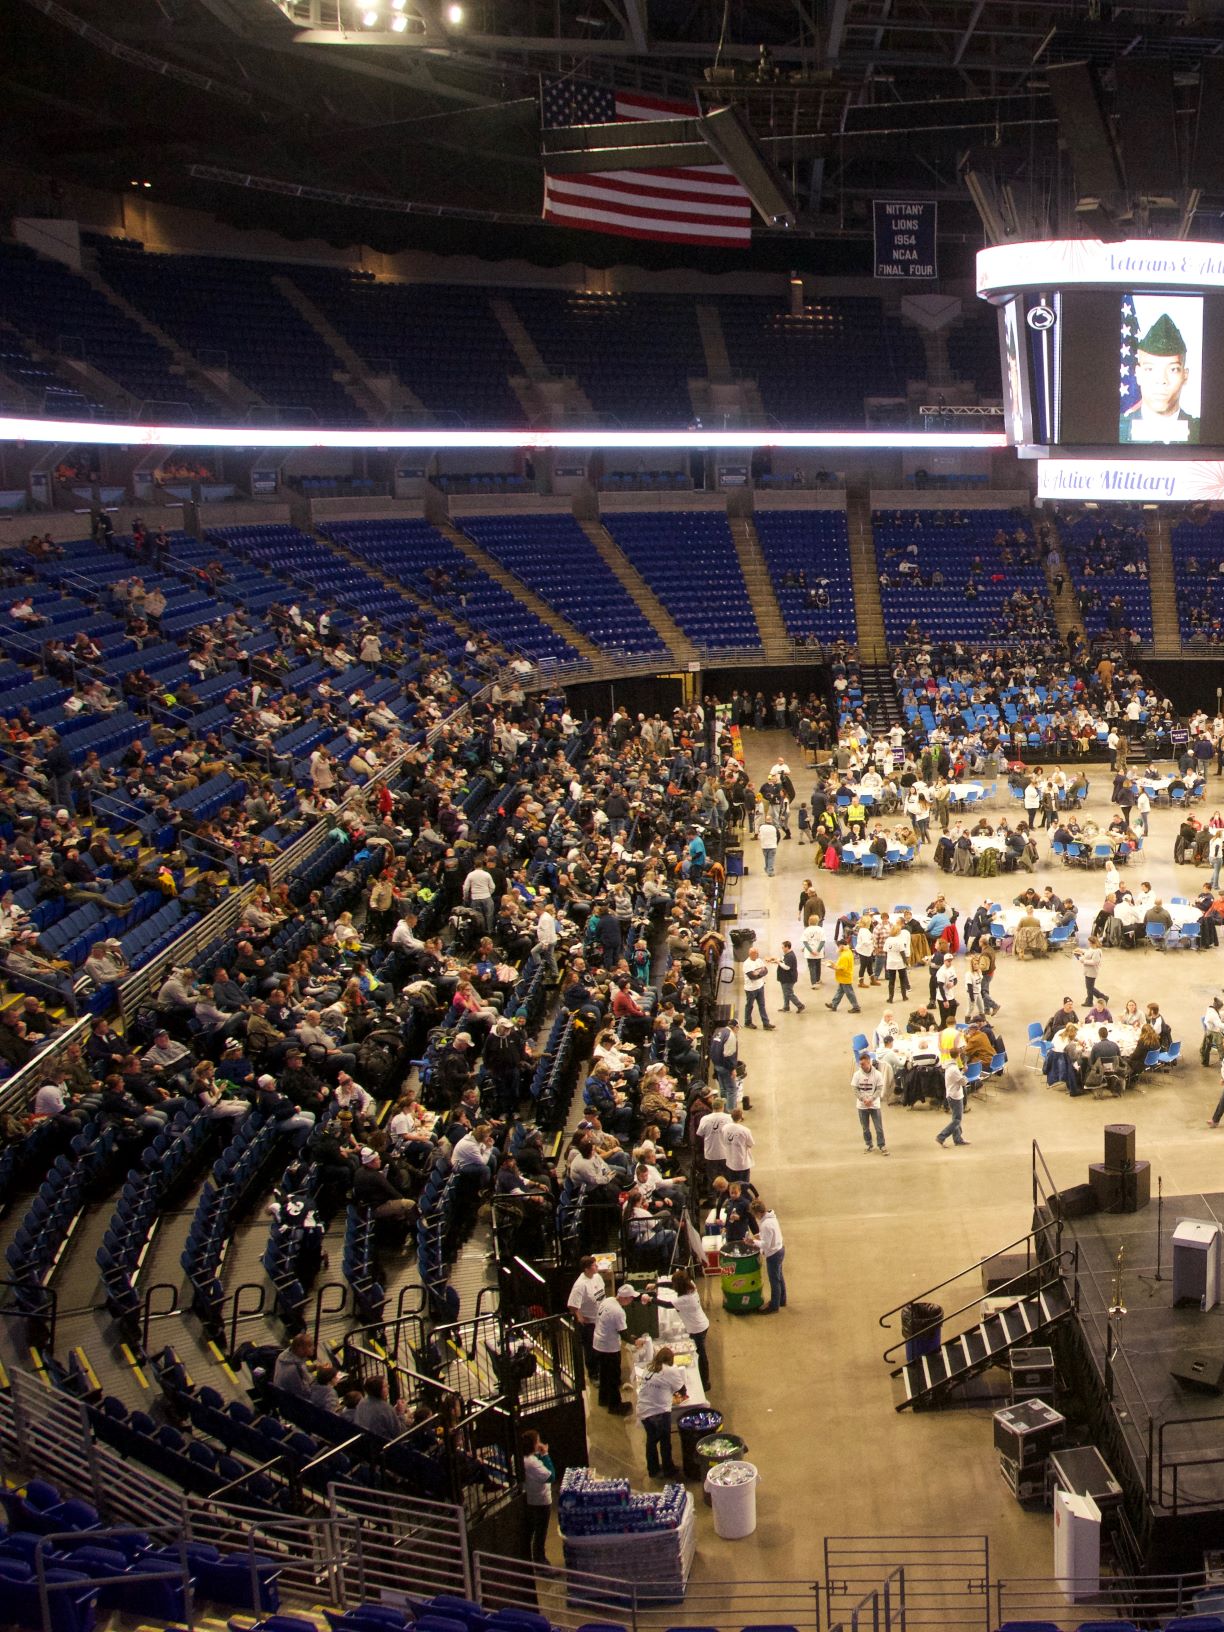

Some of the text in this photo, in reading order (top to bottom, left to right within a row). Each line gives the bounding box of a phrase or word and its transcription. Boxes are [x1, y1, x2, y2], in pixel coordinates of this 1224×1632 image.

[886, 204, 924, 215] NITTANY
[892, 219, 919, 230] LIONS
[894, 234, 917, 246] 1954
[892, 249, 919, 260] NCAA
[1105, 254, 1176, 272] Veterans
[878, 264, 933, 275] FINAL FOUR
[1053, 469, 1095, 491] Active
[1101, 470, 1176, 497] Military
